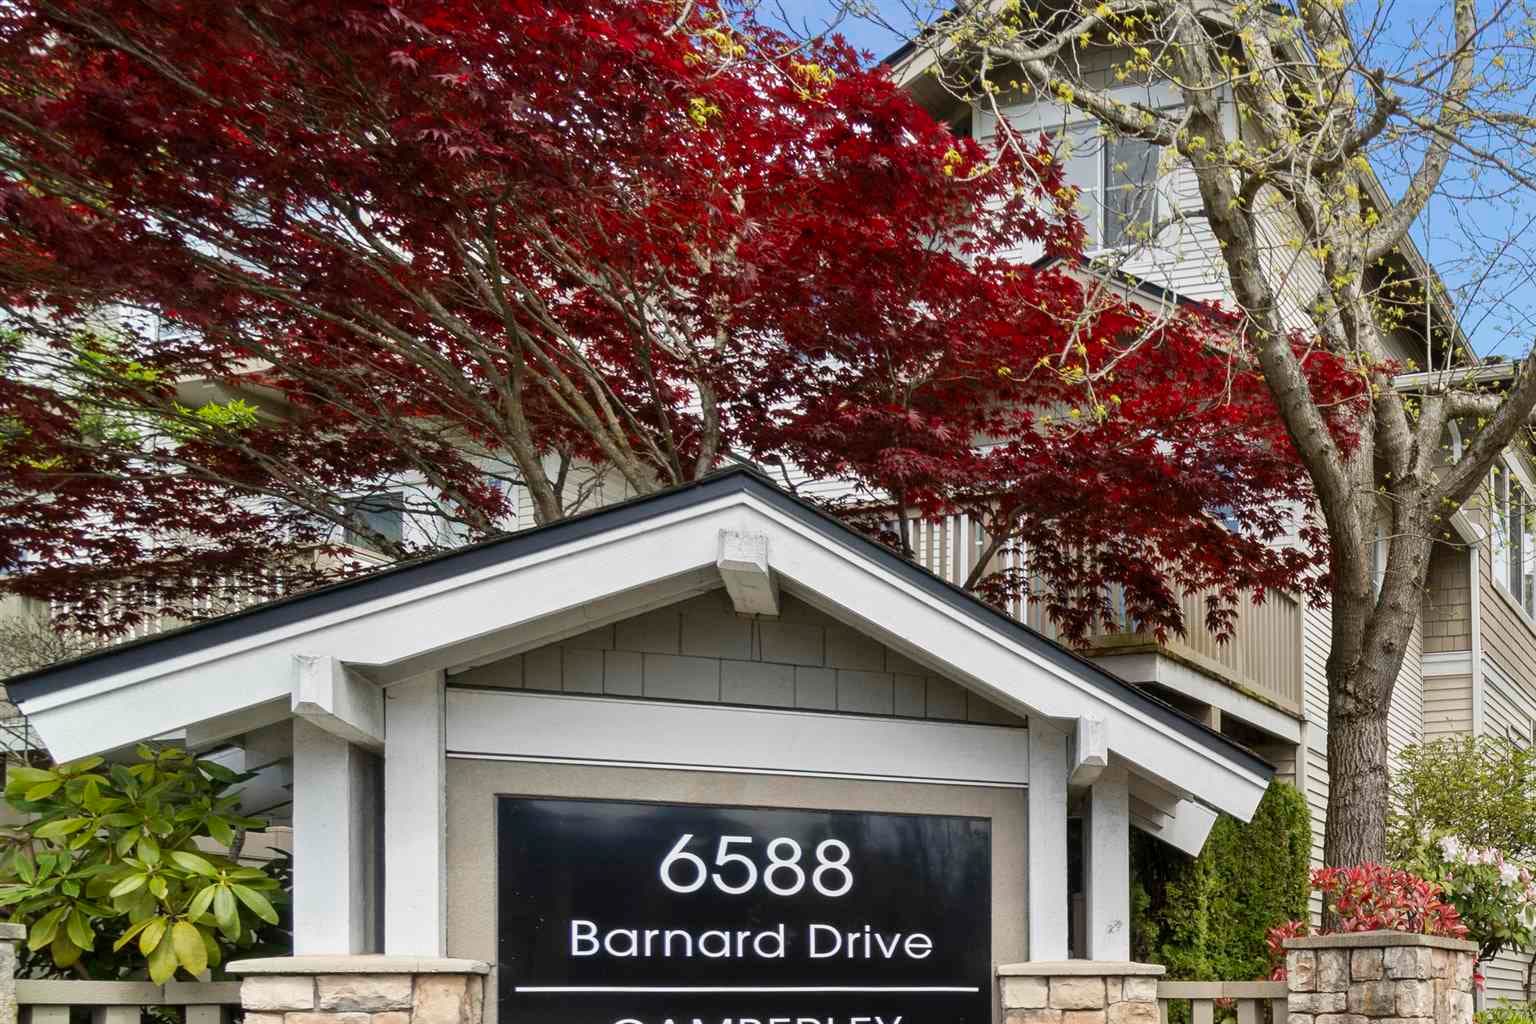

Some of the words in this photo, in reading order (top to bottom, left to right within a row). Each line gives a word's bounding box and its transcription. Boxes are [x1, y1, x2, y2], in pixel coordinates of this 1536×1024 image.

[659, 833, 854, 897] 6588
[570, 920, 786, 958] Barnard
[808, 924, 934, 959] Drive
